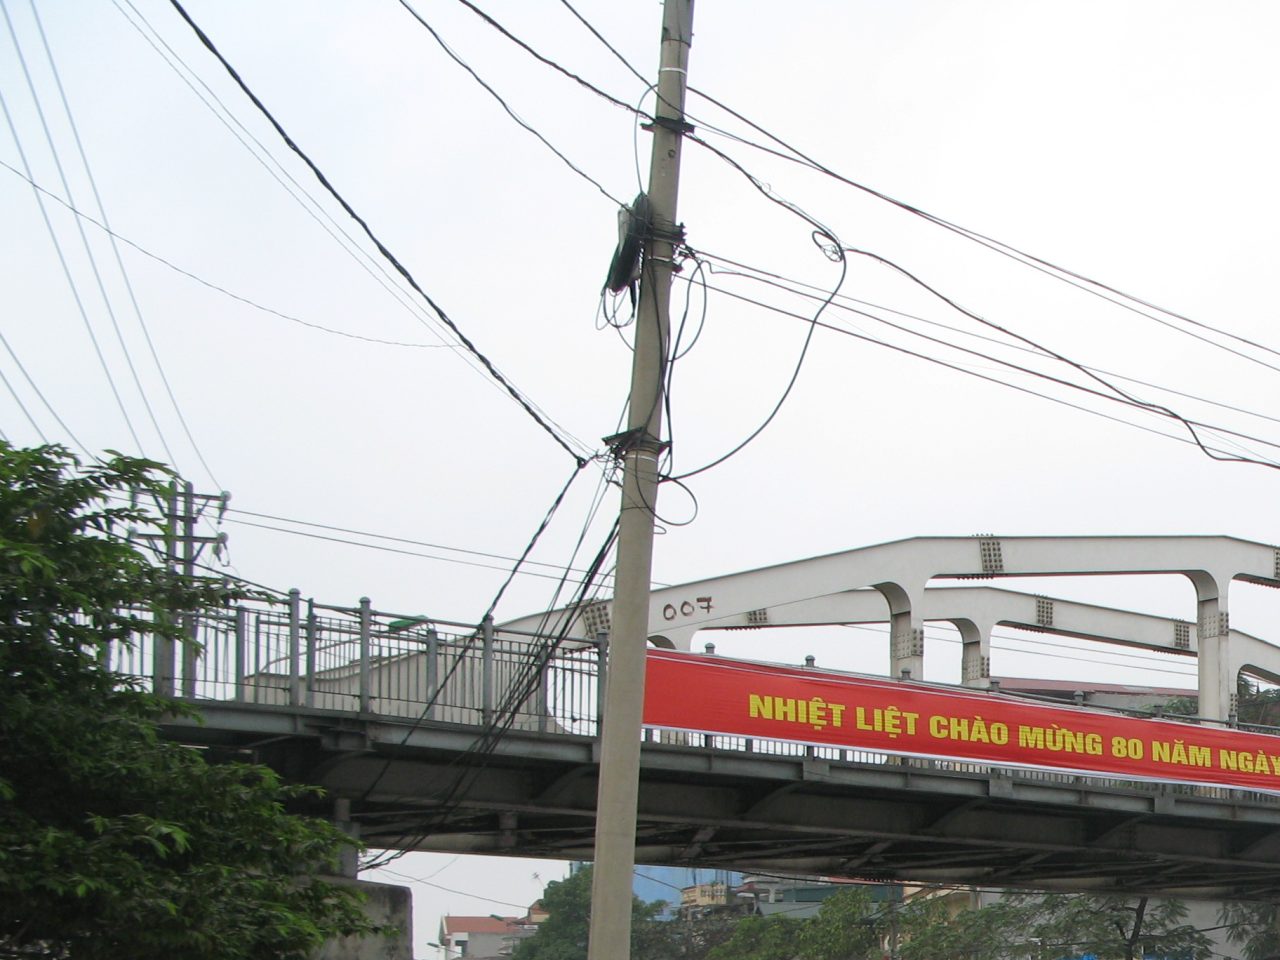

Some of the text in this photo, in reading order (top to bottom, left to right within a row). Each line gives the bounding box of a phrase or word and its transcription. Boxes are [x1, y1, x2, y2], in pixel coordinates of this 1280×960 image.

[663, 596, 714, 622] 007
[749, 693, 846, 731] NHIỆT
[855, 705, 919, 739] LIỆT
[929, 714, 1009, 746] CHÀO
[1018, 724, 1103, 756] MỪNG
[1111, 736, 1144, 760] 80
[1151, 739, 1212, 768] NĂM
